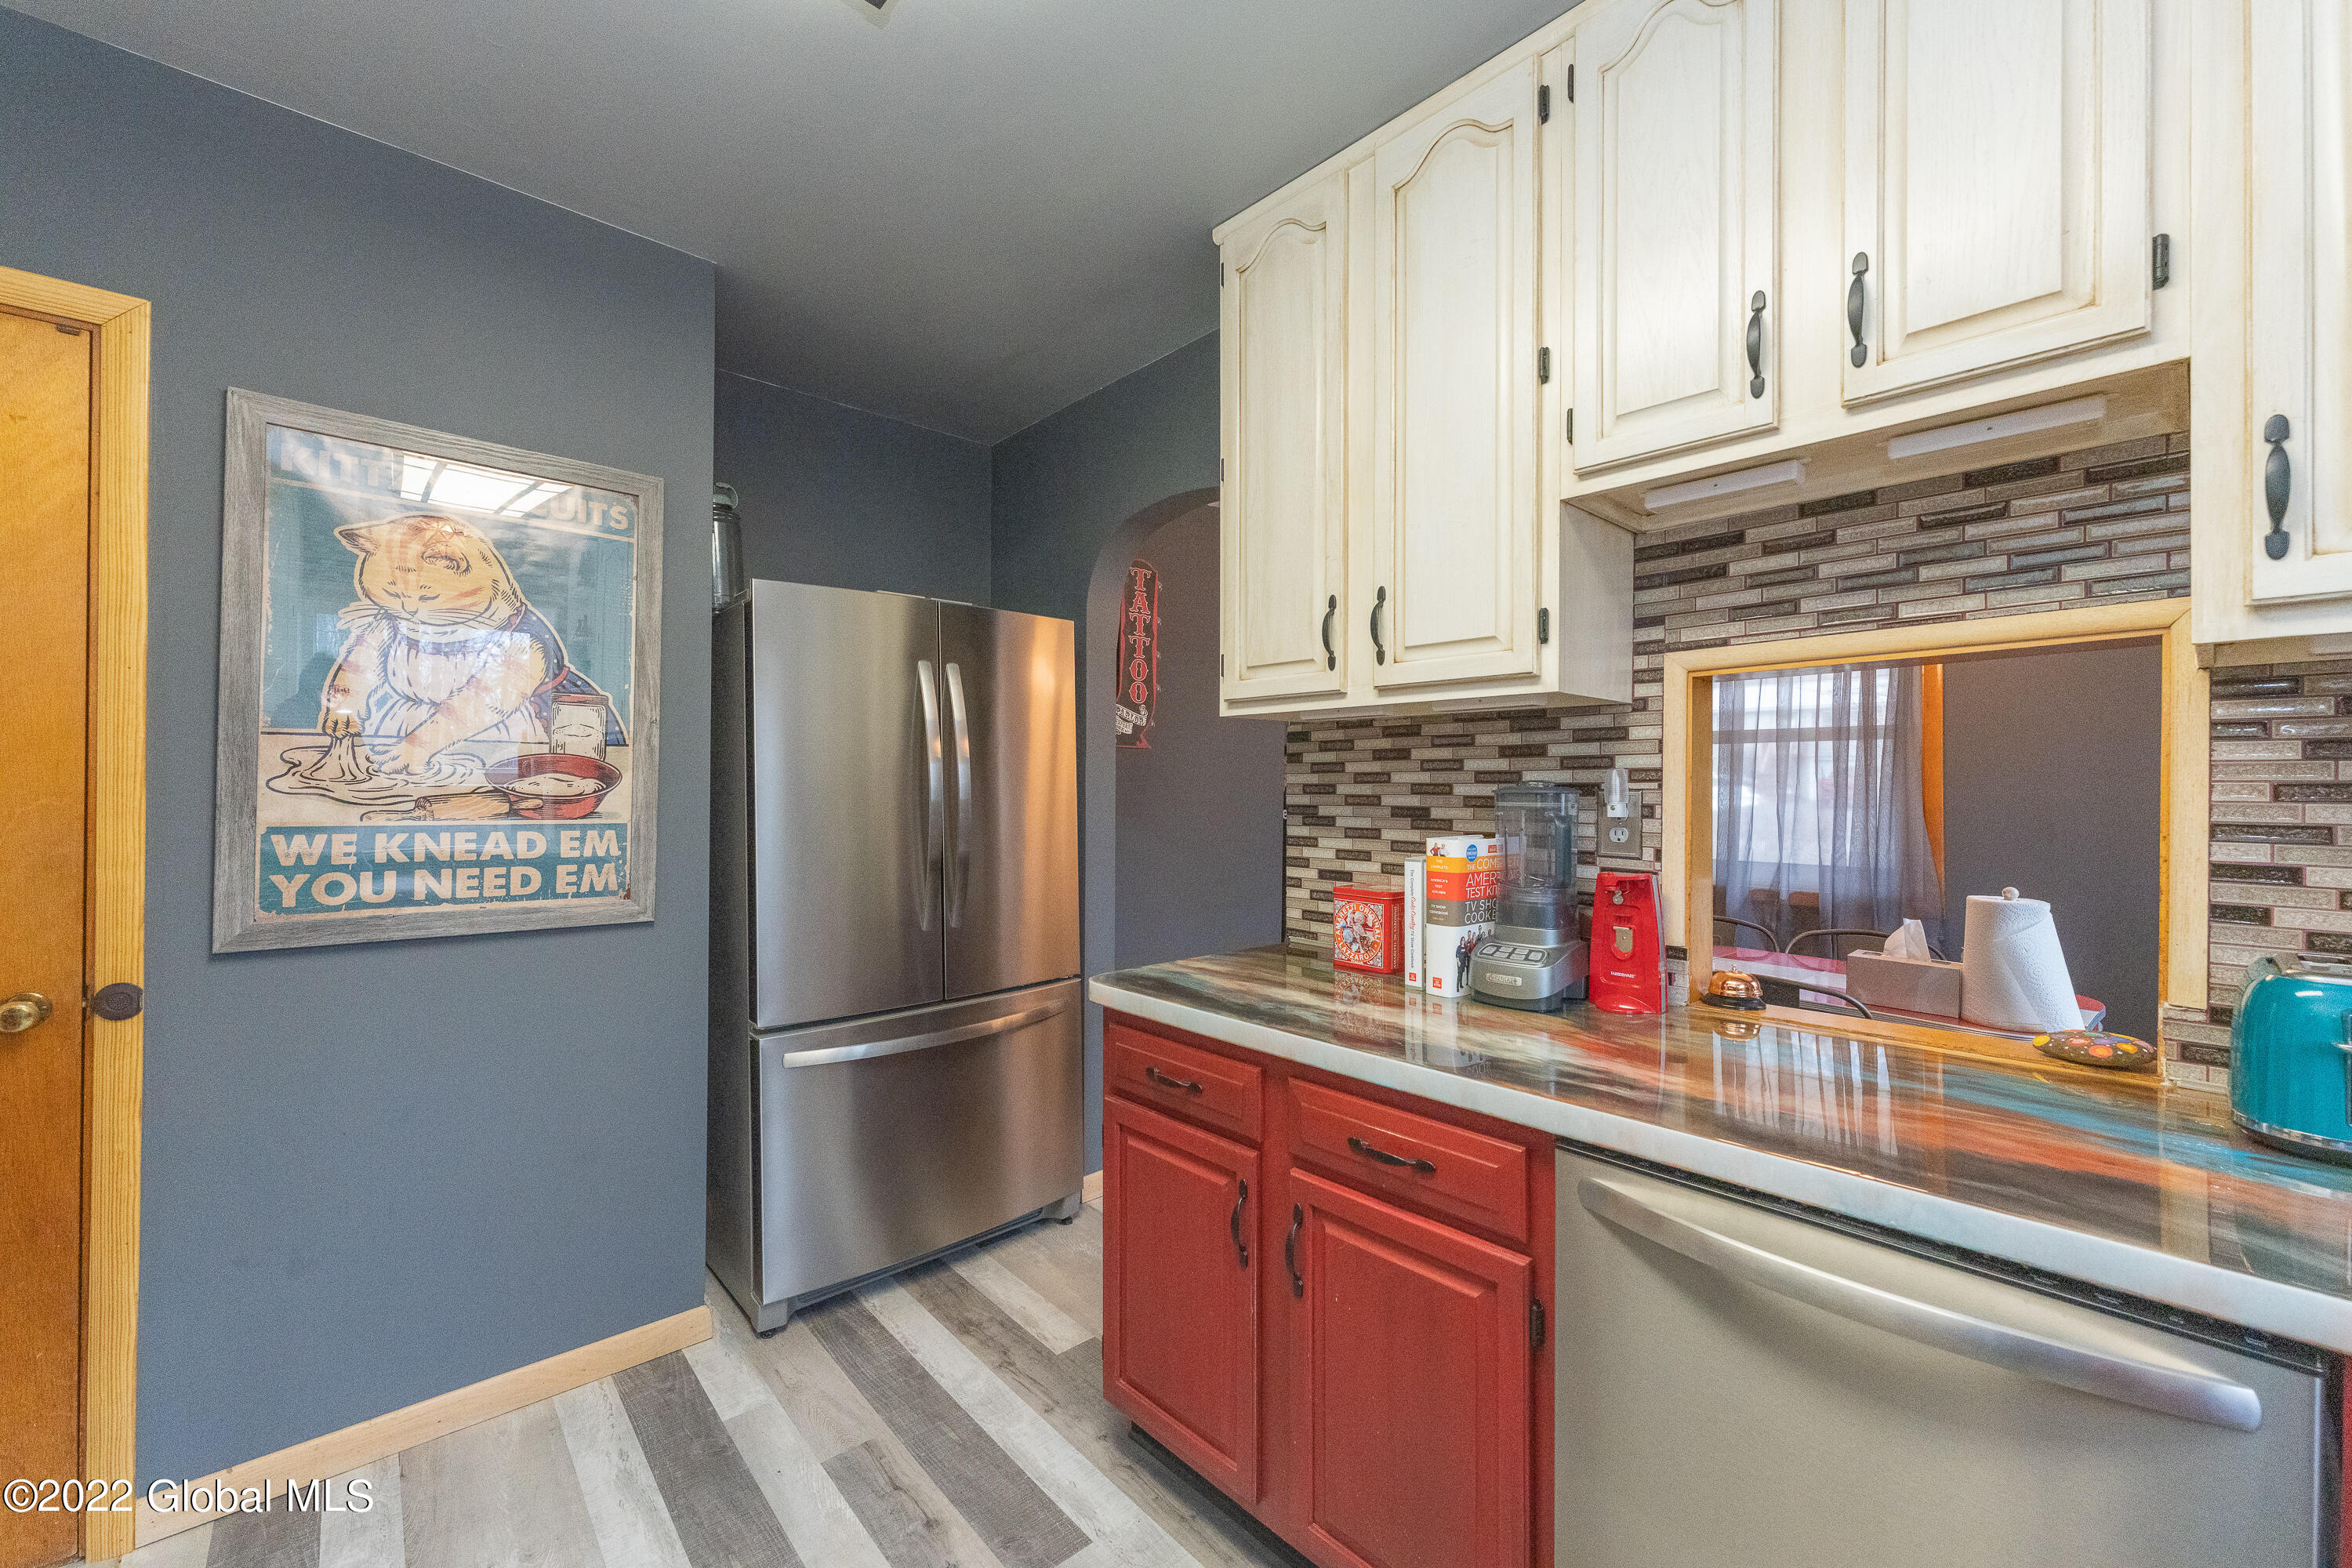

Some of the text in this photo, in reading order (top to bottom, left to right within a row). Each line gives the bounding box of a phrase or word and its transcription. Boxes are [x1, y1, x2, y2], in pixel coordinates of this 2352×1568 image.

[281, 442, 402, 488] KITT
[1128, 567, 1152, 704] TATTOO
[270, 829, 619, 866] WE KNEAD EM
[269, 863, 619, 908] YOU NEED EM
[1465, 886, 1486, 899] TEST
[1335, 904, 1357, 934] AMARETTI
[1465, 900, 1478, 913] TV
[1338, 942, 1376, 961] LAZZARONI
